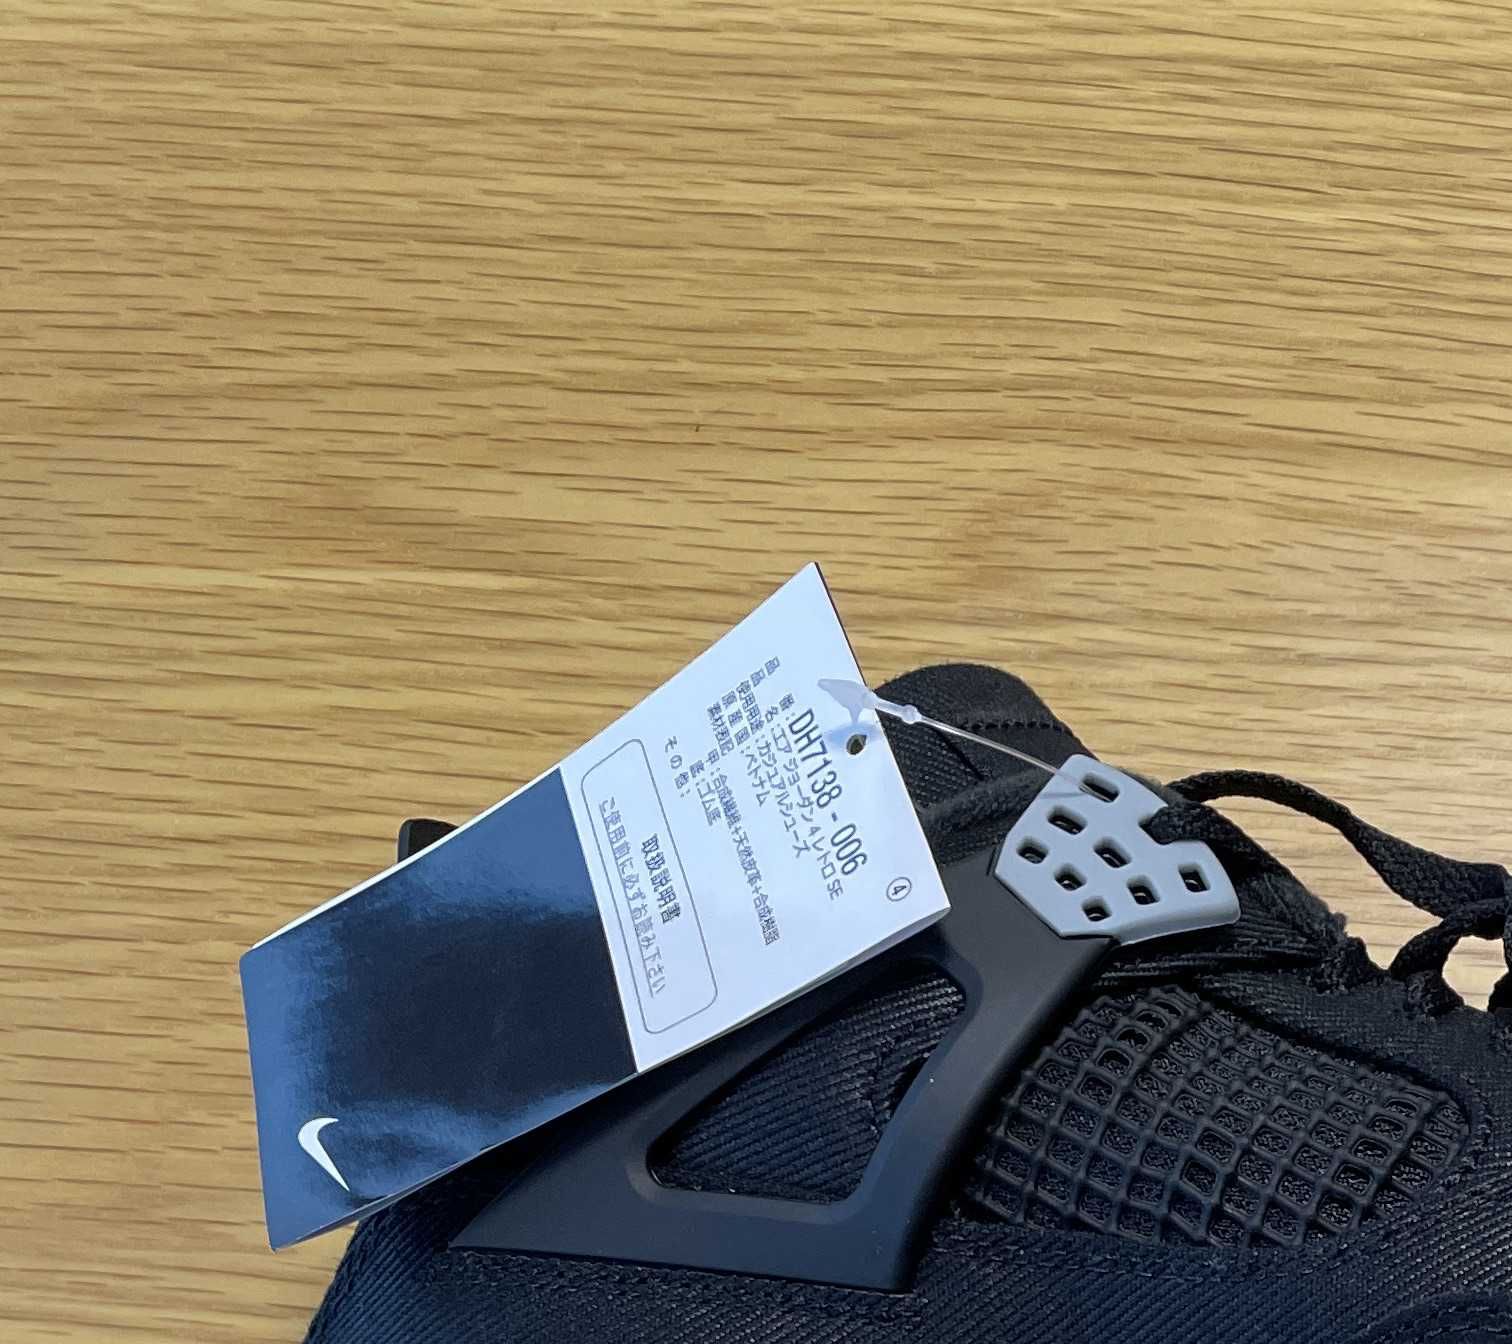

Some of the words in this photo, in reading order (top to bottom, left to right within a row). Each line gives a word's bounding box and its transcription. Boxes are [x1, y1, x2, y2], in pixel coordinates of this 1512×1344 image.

[641, 833, 685, 925] 取扱説明書
